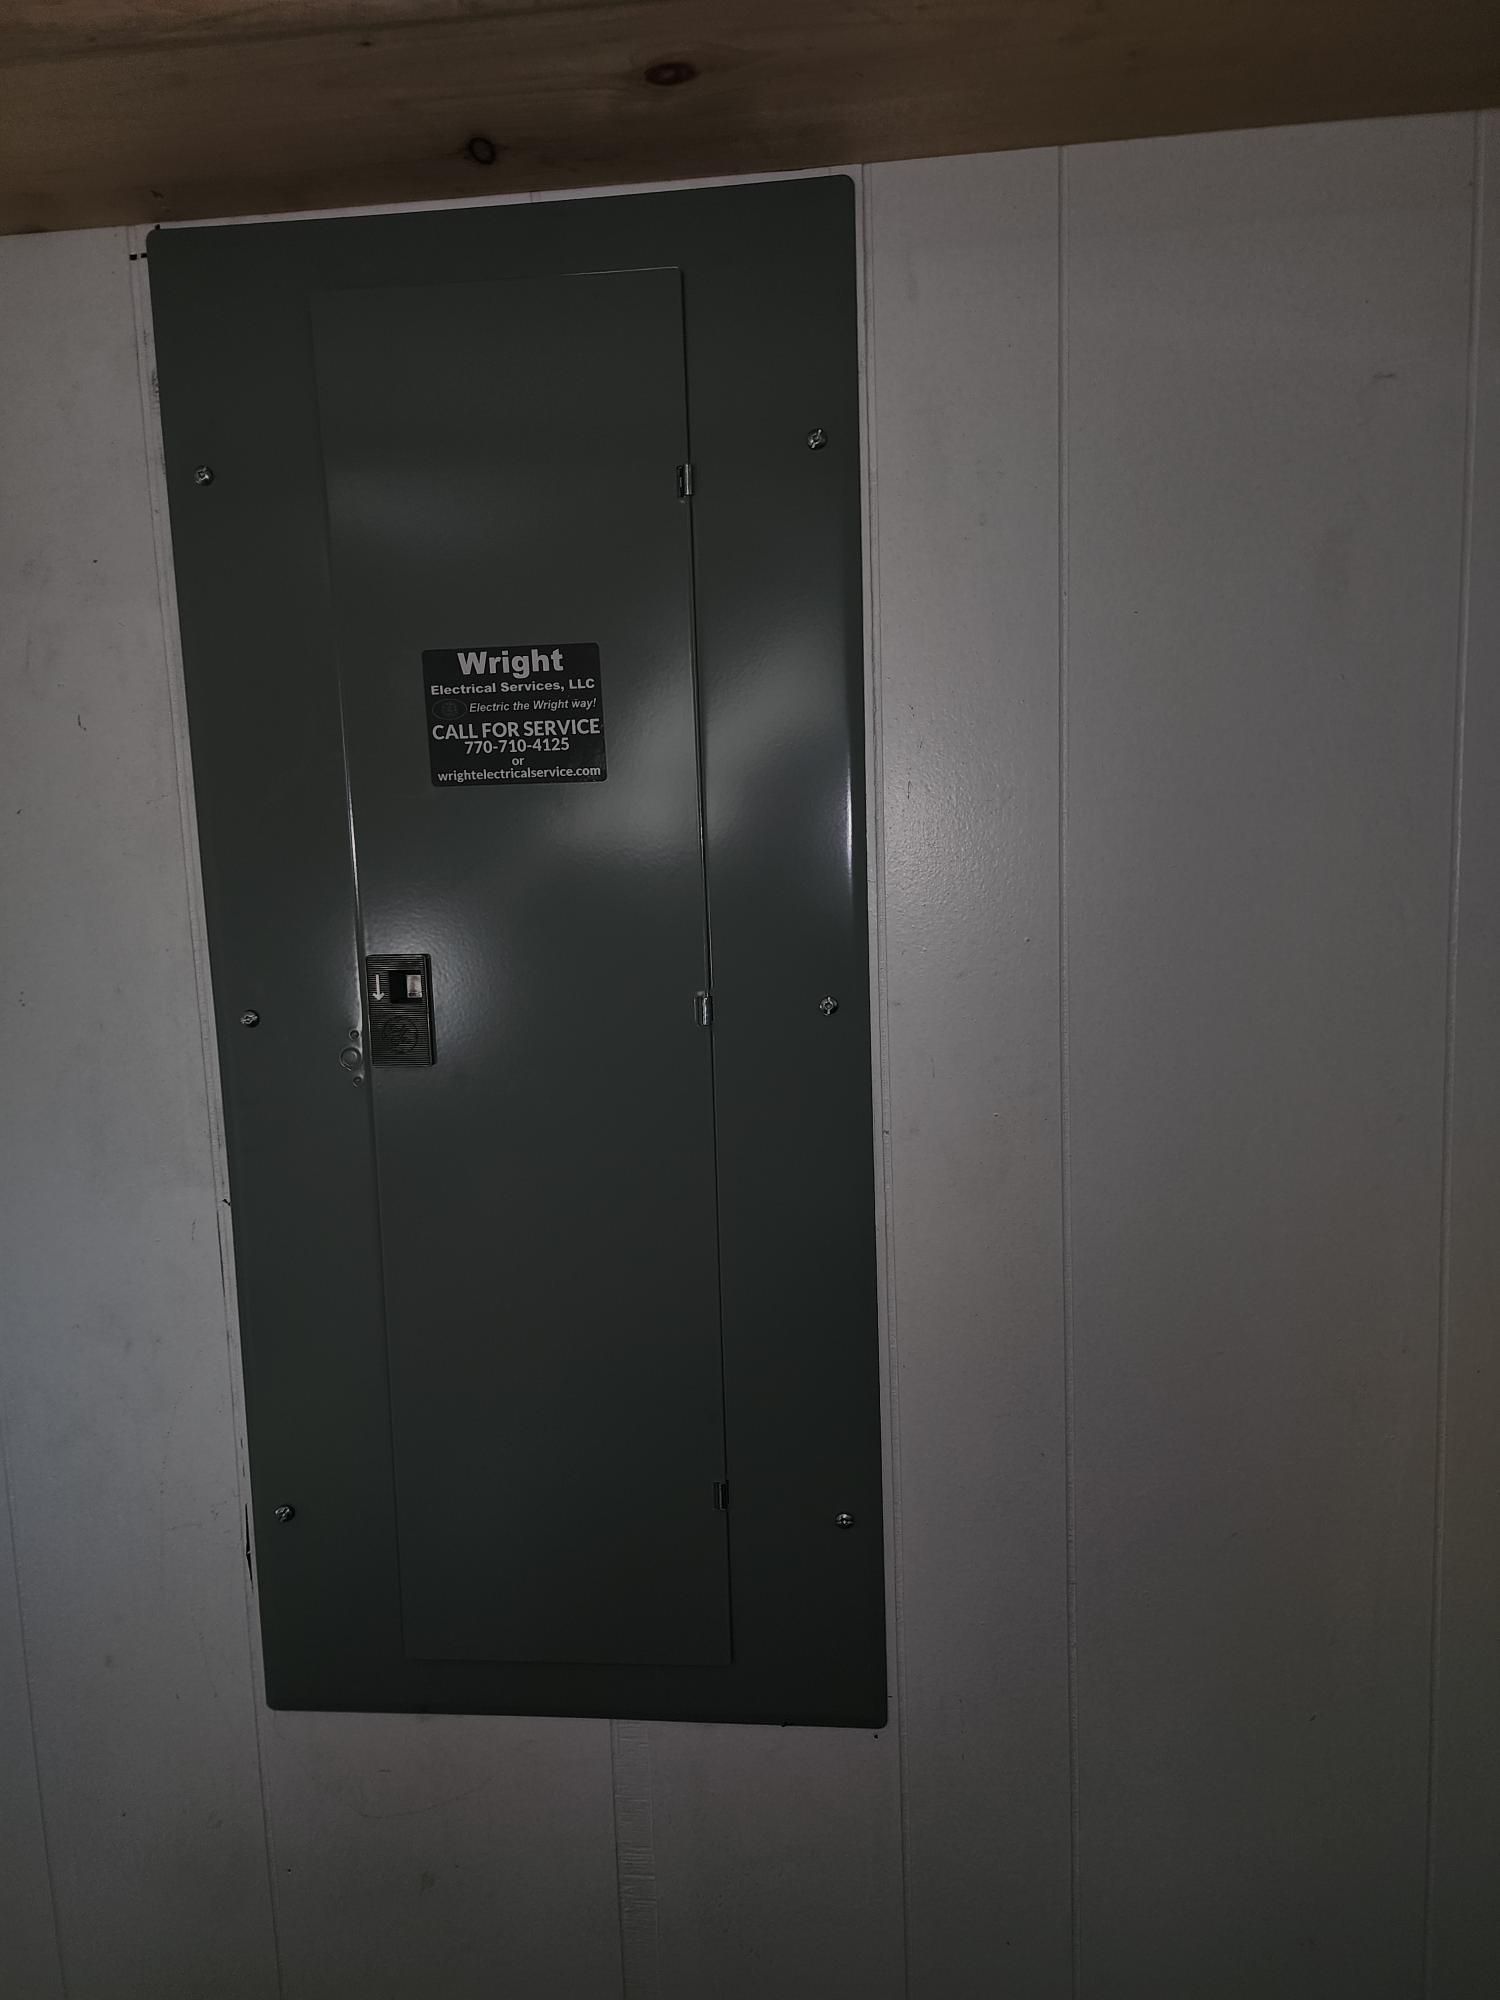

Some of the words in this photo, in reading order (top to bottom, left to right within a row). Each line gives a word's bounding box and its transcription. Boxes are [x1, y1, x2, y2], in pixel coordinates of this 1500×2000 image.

[457, 648, 564, 679] Wright
[431, 683, 496, 695] Electrical
[500, 680, 565, 692] Services,
[569, 679, 595, 689] LLC
[469, 701, 510, 713] Electric
[513, 700, 530, 710] the
[533, 699, 569, 711] Wright
[571, 698, 597, 710] way!
[432, 723, 478, 740] CALL
[482, 721, 520, 738] FOR
[524, 718, 600, 736] SERVICE
[464, 737, 570, 754] 770-710-4125
[511, 757, 525, 766] or
[438, 766, 601, 782] wrightelectricalservice.com
